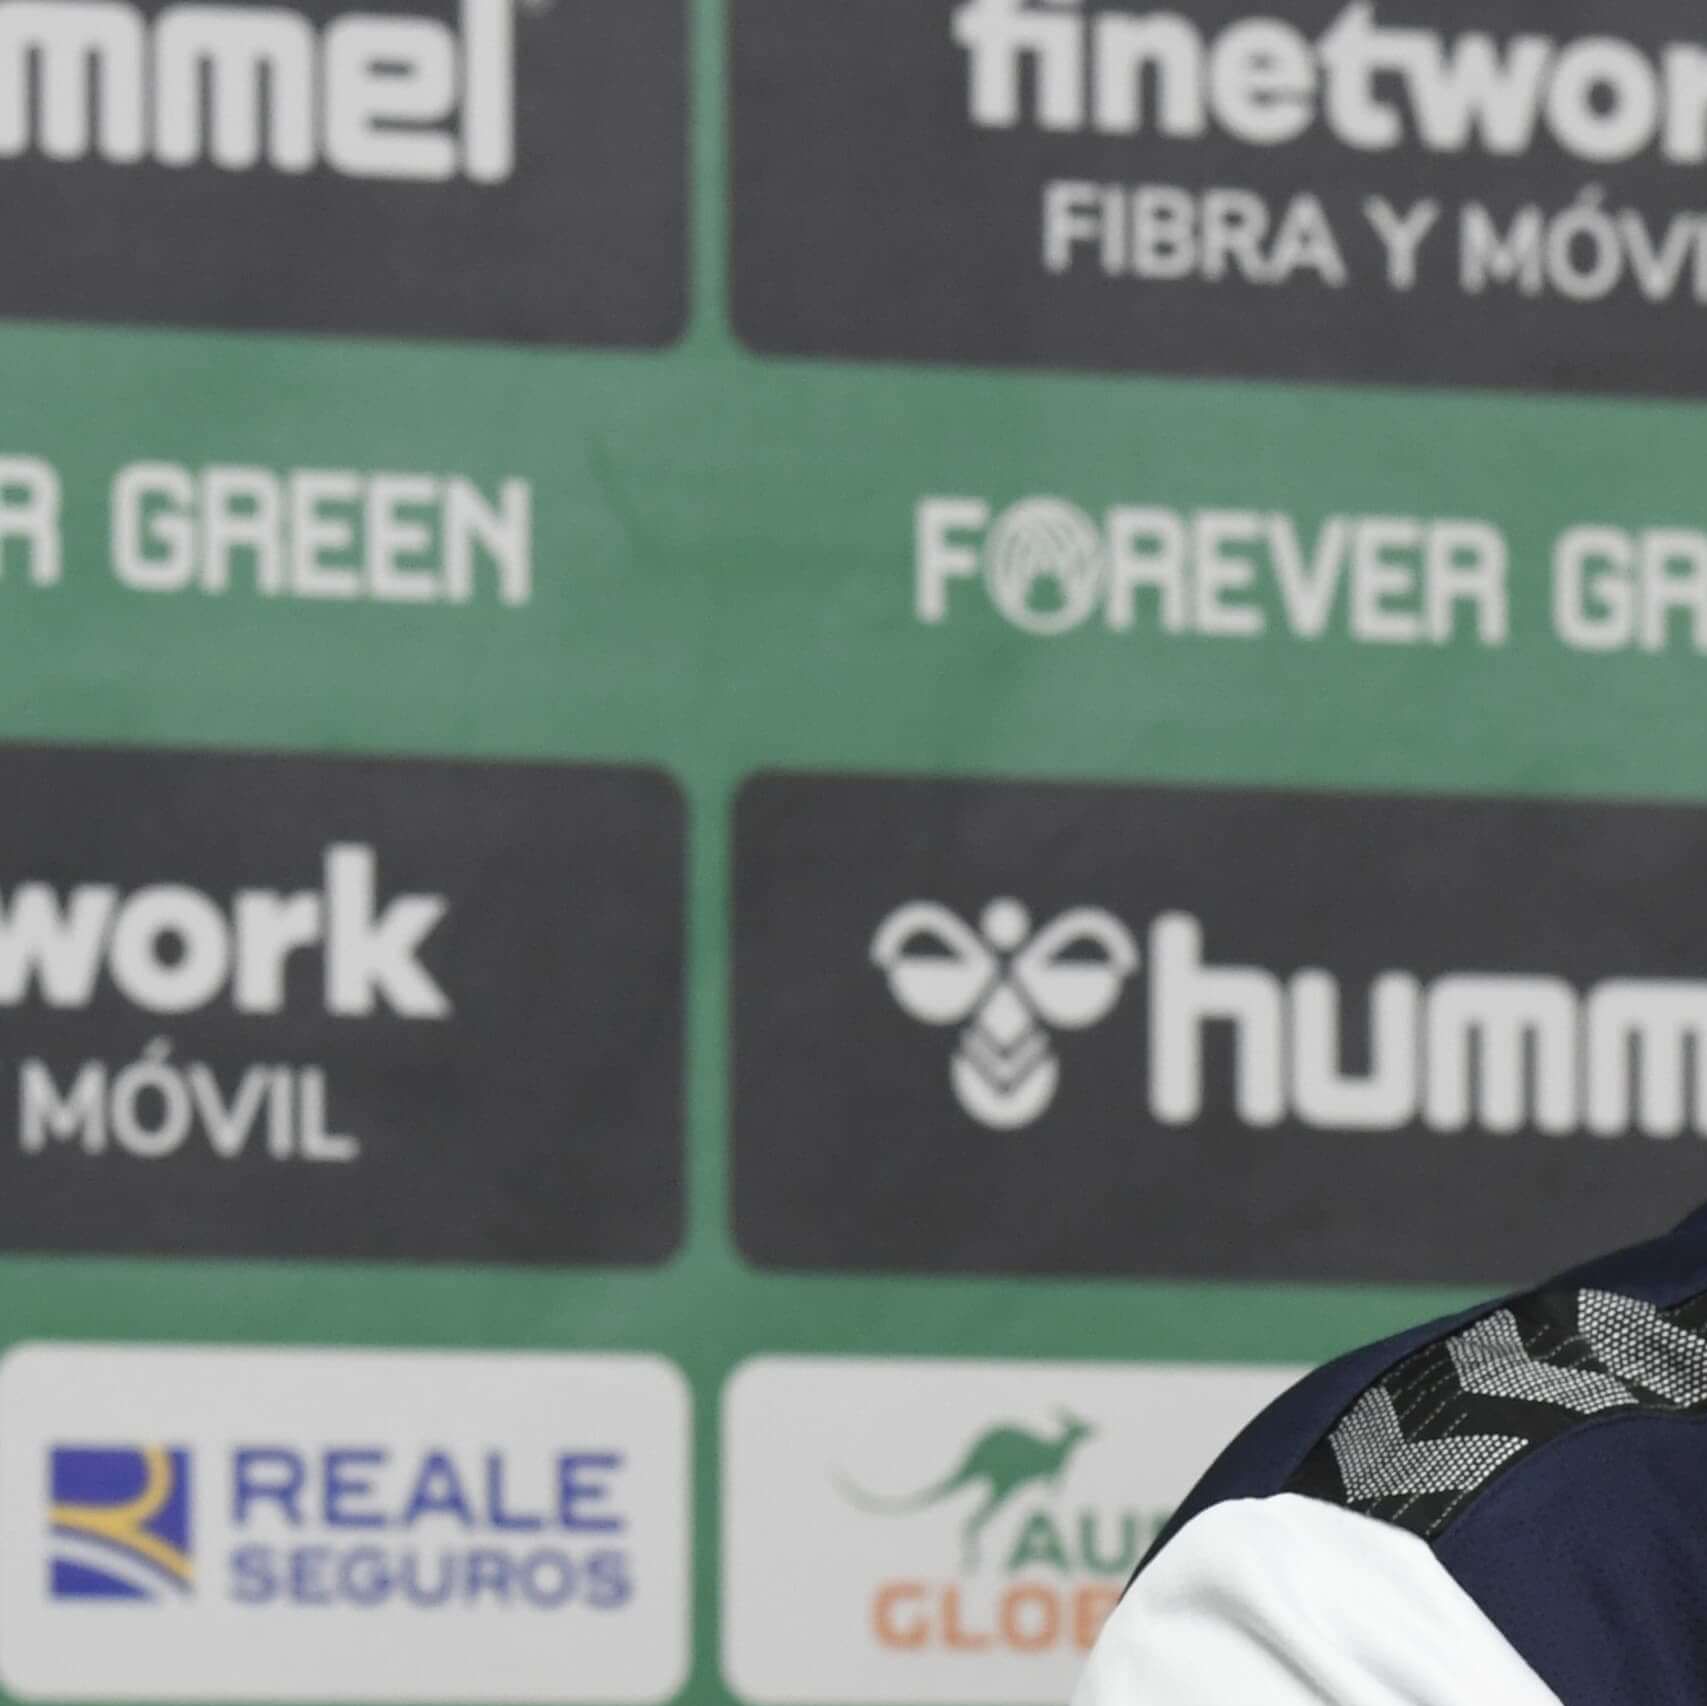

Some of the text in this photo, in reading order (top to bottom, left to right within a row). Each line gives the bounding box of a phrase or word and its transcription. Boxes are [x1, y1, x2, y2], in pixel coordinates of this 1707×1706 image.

[1044, 181, 1345, 284] FIBRA
[1366, 199, 1437, 288] Y
[112, 463, 530, 604] GREEN
[916, 497, 1507, 644] FOREVER
[21, 1039, 357, 1160] MÓVIL
[231, 1446, 623, 1534] REALE
[229, 1544, 634, 1610] SEGUROS
